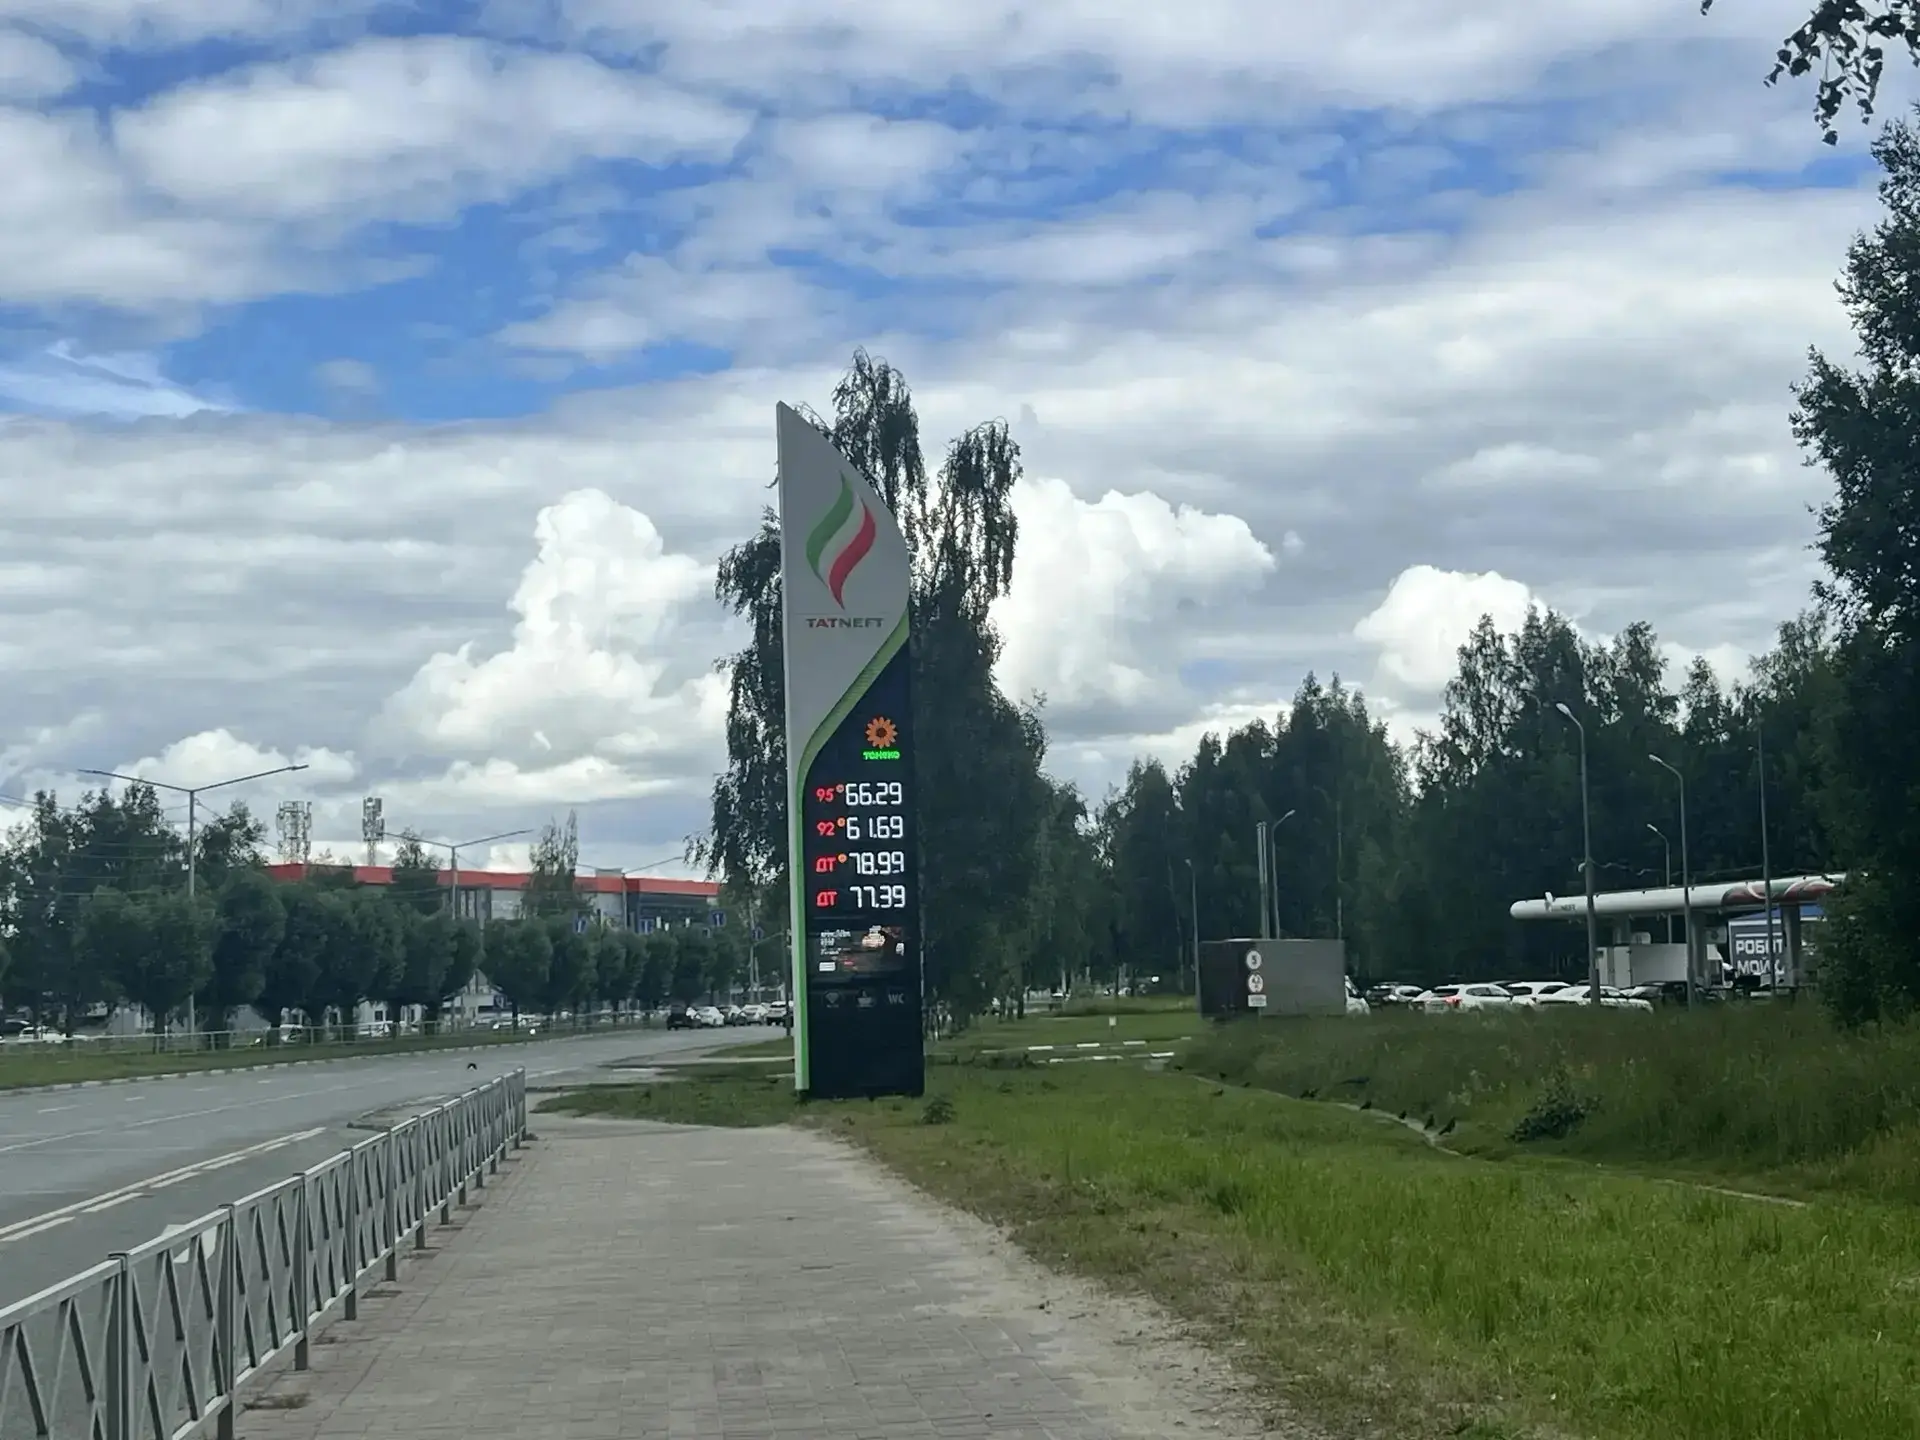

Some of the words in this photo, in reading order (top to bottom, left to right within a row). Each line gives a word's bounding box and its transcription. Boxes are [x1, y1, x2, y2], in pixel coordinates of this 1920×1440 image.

[805, 617, 885, 628] TATNEFT
[816, 787, 835, 803] 95
[845, 782, 903, 806] 66.29
[816, 821, 836, 837] 92
[846, 815, 904, 839] 61.69
[848, 851, 905, 875] 78.99
[849, 884, 906, 909] 77.39
[887, 993, 905, 1004] WC
